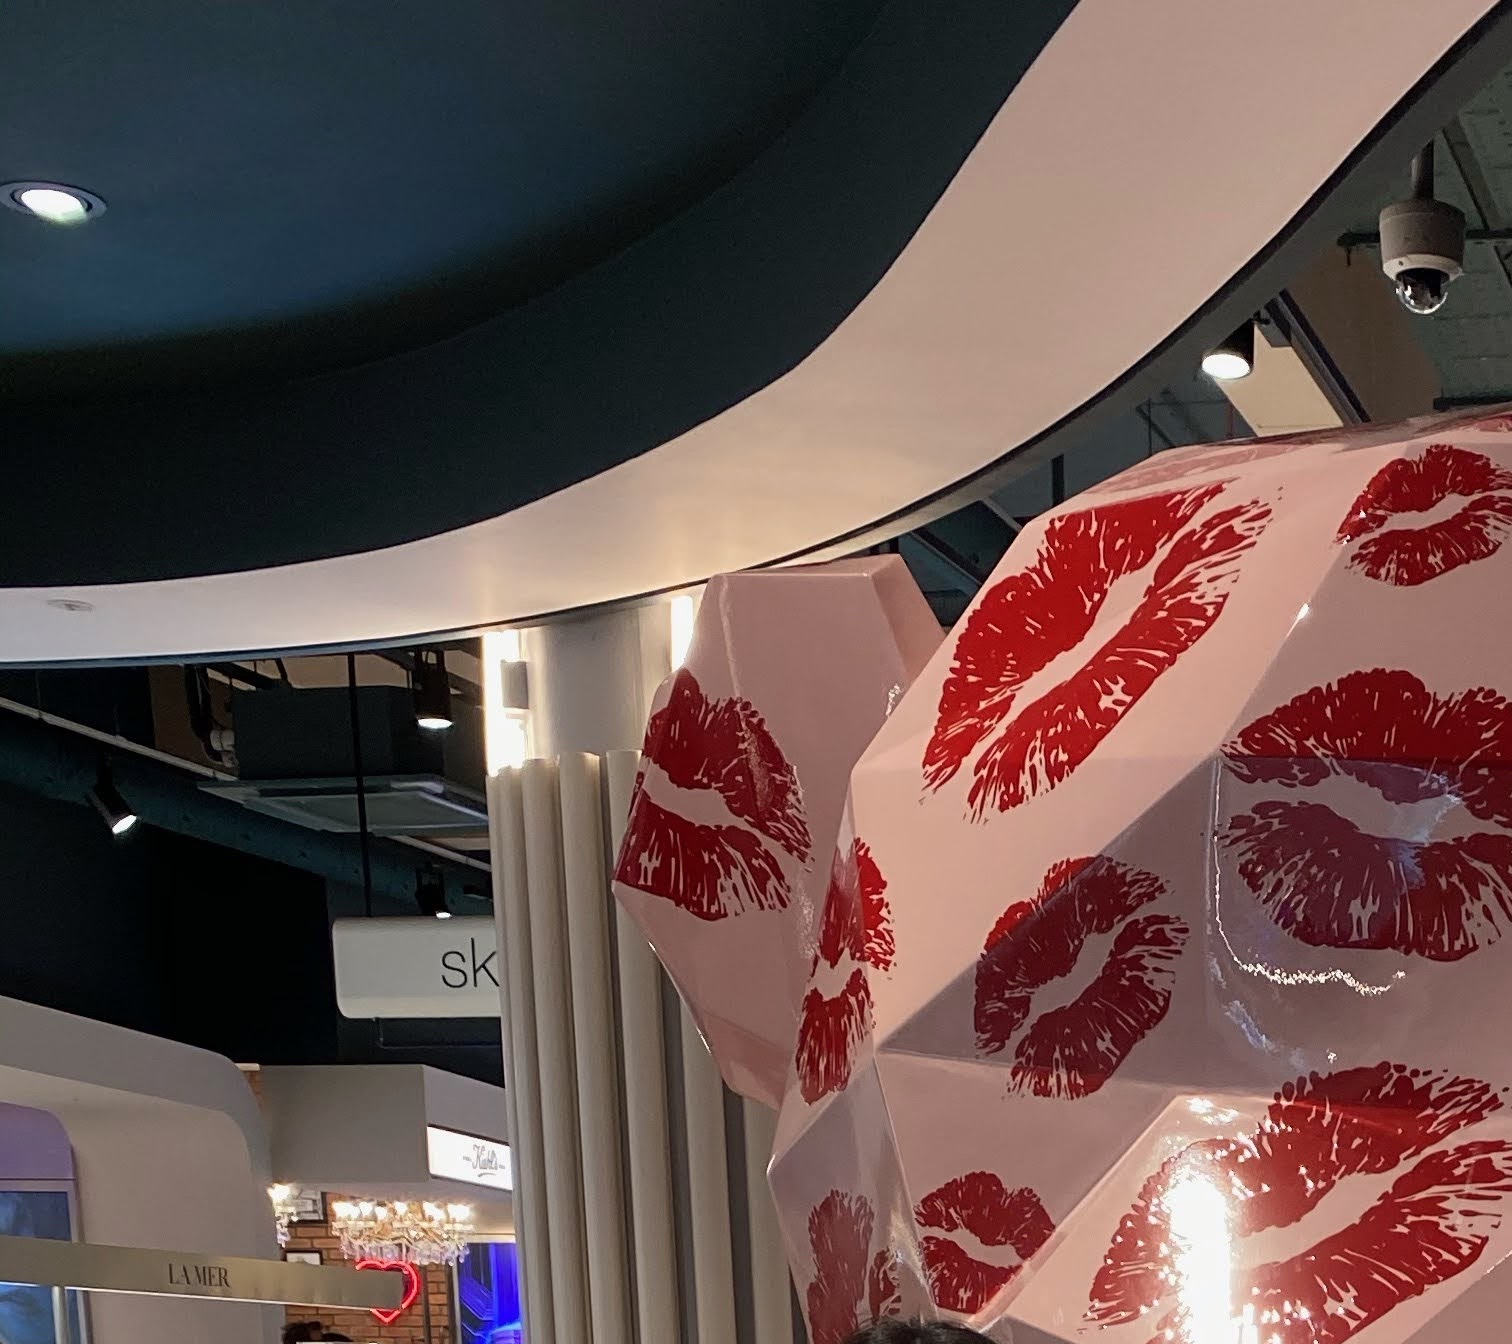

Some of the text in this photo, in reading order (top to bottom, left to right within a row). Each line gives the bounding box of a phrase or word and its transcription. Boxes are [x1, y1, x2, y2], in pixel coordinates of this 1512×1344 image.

[441, 937, 500, 988] sk
[168, 1263, 231, 1288] LA MER
